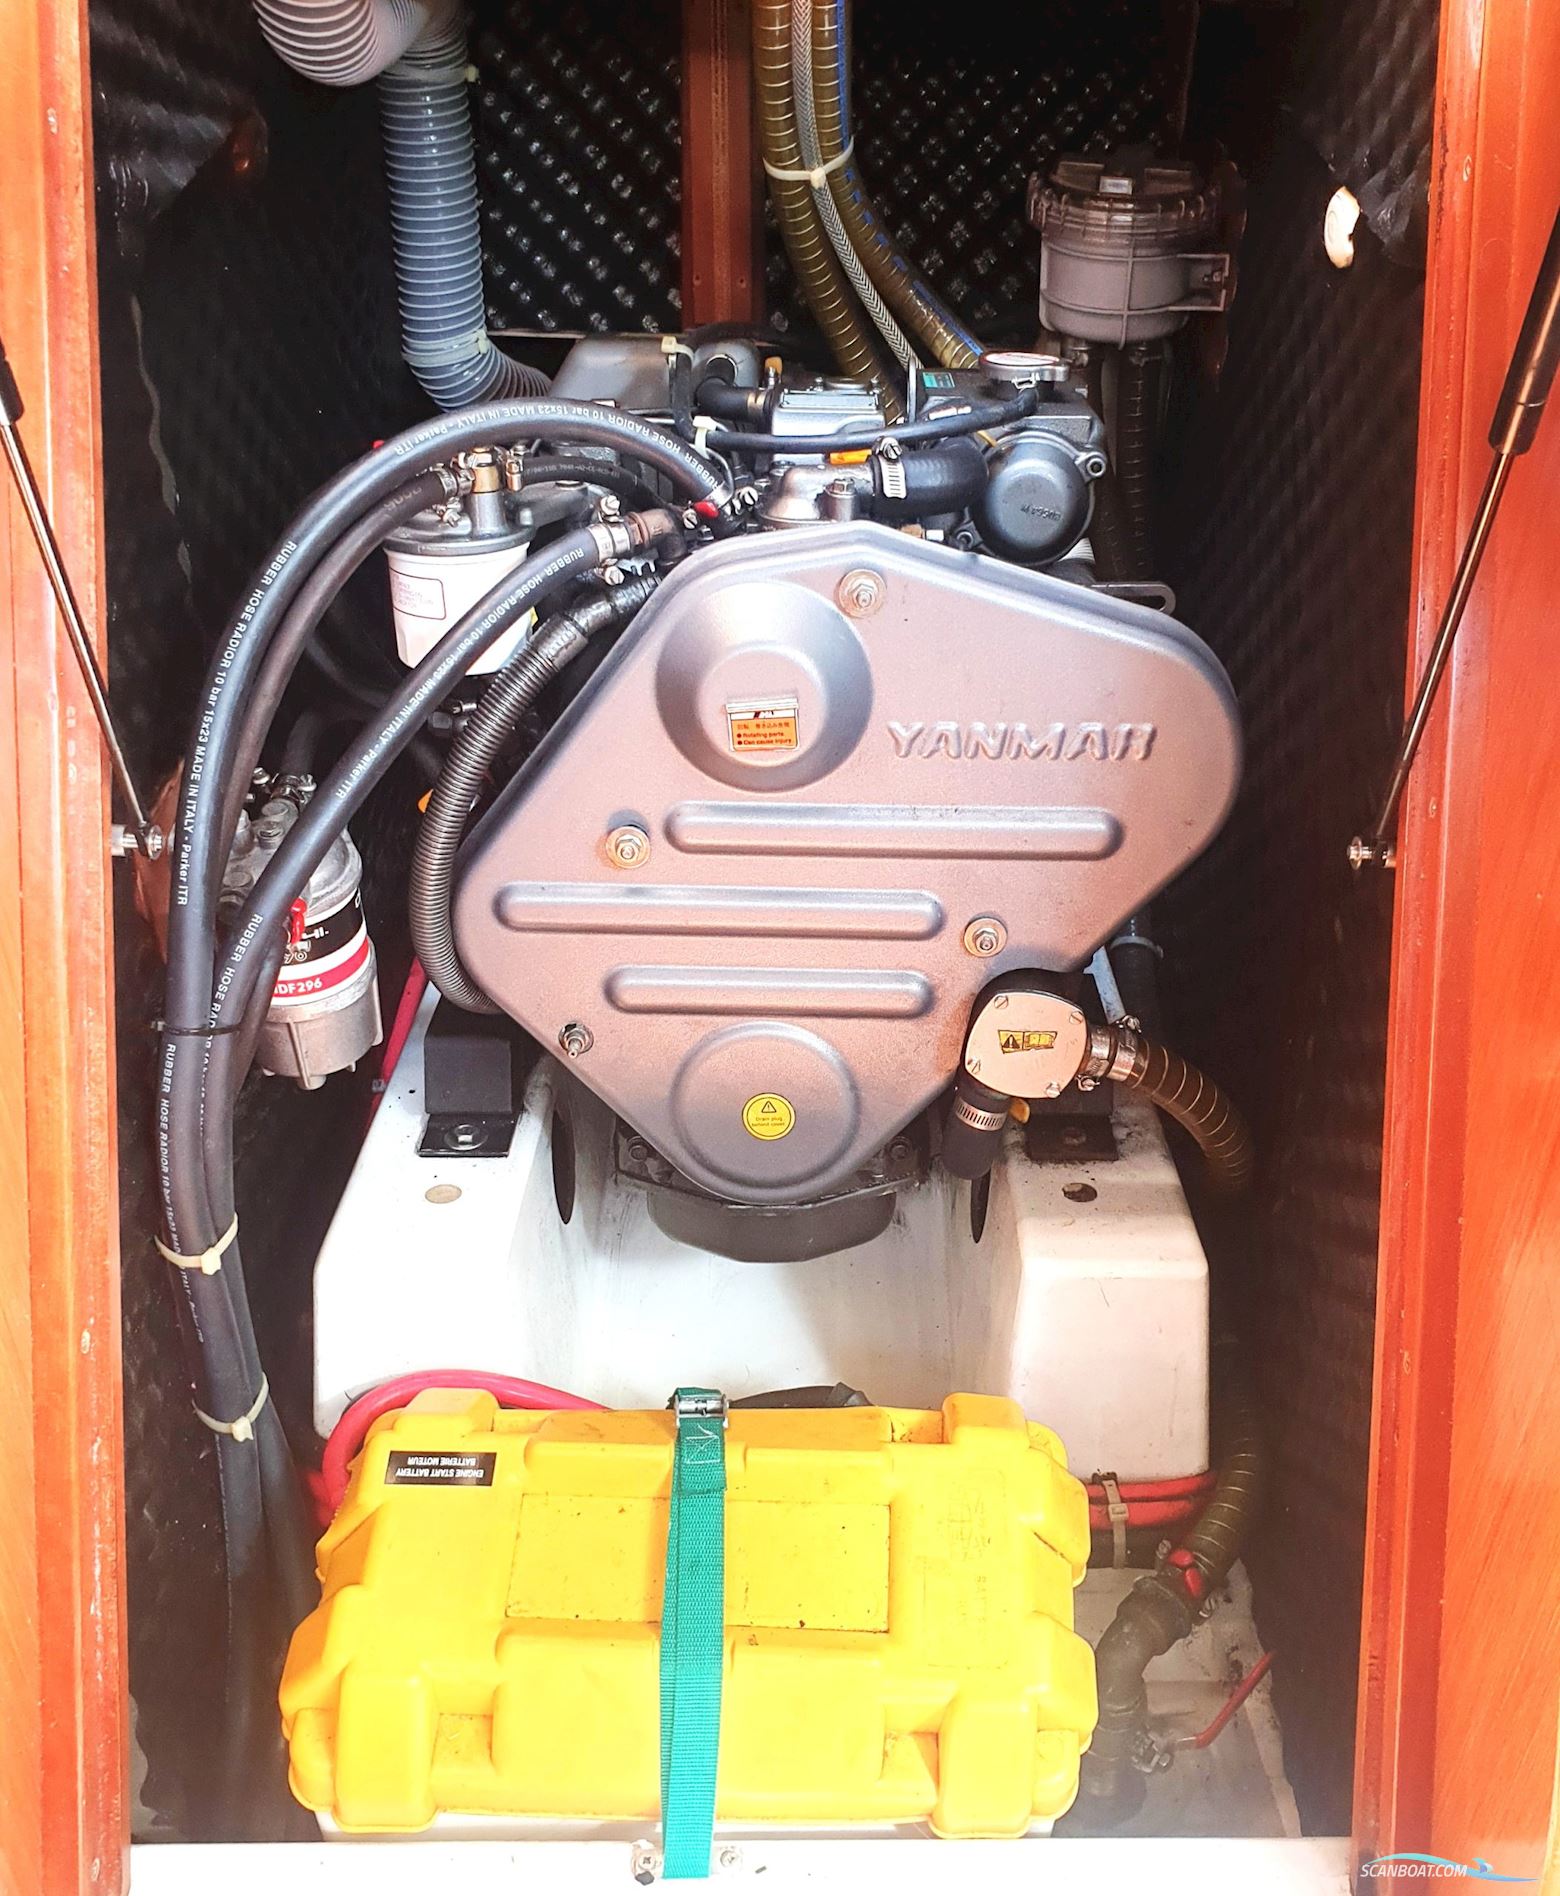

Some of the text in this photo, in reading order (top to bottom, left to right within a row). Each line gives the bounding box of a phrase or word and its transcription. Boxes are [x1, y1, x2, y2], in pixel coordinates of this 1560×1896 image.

[457, 413, 484, 429] ITALY
[484, 410, 501, 421] IN
[504, 405, 535, 417] MADE
[537, 405, 568, 415] 15x23
[571, 405, 589, 415] bar
[592, 410, 603, 419] 10
[608, 413, 650, 436] RADIOR
[414, 427, 448, 446] Parker
[651, 432, 681, 453] HOSE
[394, 442, 414, 456] ITR
[684, 452, 723, 491] RUBBER
[261, 541, 298, 586] RUBBER
[543, 547, 585, 577] RUBBER
[515, 575, 543, 600] HOSE
[240, 588, 265, 621] HOSE
[481, 595, 518, 629] RADIOR
[470, 627, 483, 640] 10
[220, 622, 247, 668] RADIOR
[456, 638, 474, 653] bar
[214, 671, 227, 684] 10
[208, 686, 222, 707] bar
[409, 678, 437, 707] MADE
[399, 705, 414, 718] IN
[198, 710, 215, 743] 15x23
[379, 716, 404, 745] ITALY
[887, 721, 1157, 761] YANMAR
[190, 745, 206, 781] MADE
[350, 748, 377, 781] Parker
[188, 784, 200, 797] IN
[336, 780, 354, 799] ITR
[183, 800, 197, 834] ITALY
[180, 844, 192, 882] Parker
[177, 885, 189, 906] ITR
[231, 914, 264, 962] RUBBER
[215, 967, 236, 1001] HOSE
[161, 1043, 177, 1093] RUBBER
[159, 1098, 170, 1131] HOSE
[159, 1131, 170, 1174] RADIOR
[161, 1175, 170, 1188] 10
[171, 1232, 182, 1253] MAD
[407, 1456, 476, 1466] BATTERIE MOTEUR
[395, 1468, 485, 1478] ENGINE START BATTERY
